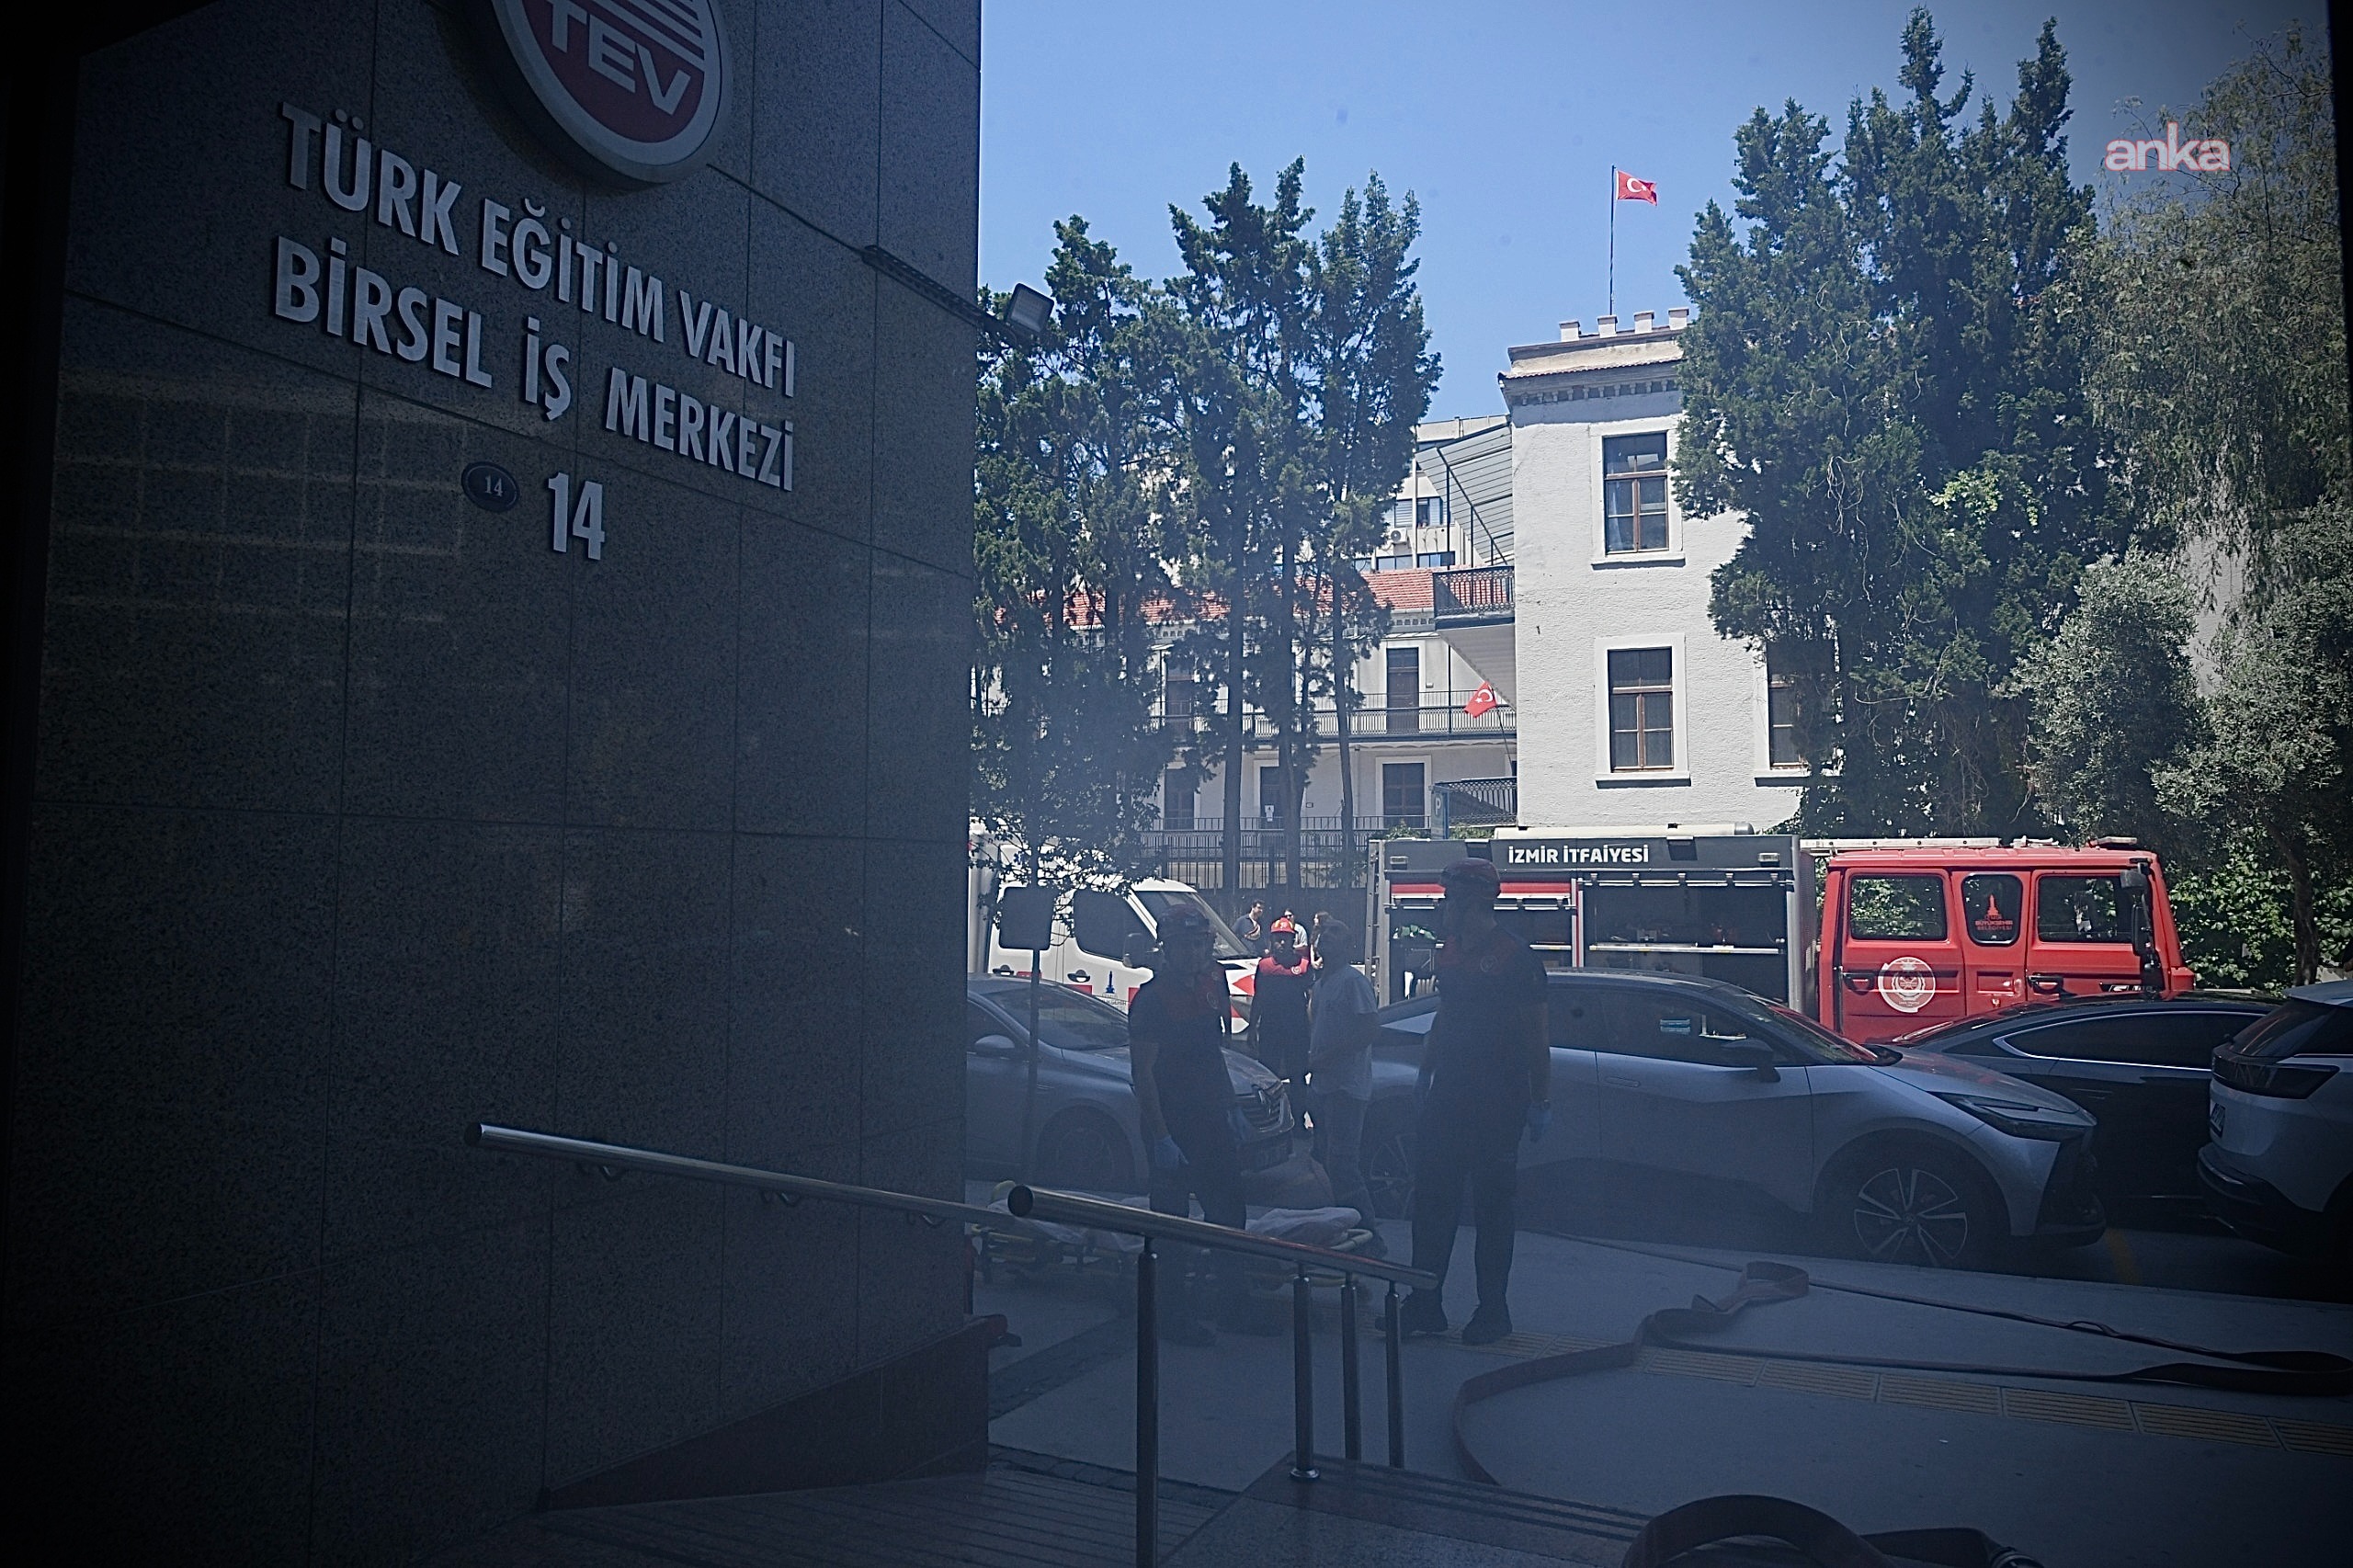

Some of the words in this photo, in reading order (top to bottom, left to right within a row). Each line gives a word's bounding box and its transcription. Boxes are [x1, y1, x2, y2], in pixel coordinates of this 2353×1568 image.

[552, 0, 691, 116] TEV
[282, 101, 461, 256] TÜRK
[482, 198, 665, 344] EĞİTİM
[679, 290, 795, 398] VAKFI
[275, 235, 493, 388] BİRSEL
[525, 317, 571, 421] İŞ
[606, 367, 794, 492] MERKEZİ
[484, 475, 504, 497] 14
[548, 472, 605, 560] 14
[1436, 798, 1441, 815] P
[1508, 845, 1559, 863] İZMİR
[1563, 844, 1649, 863] İTFAİYESİ
